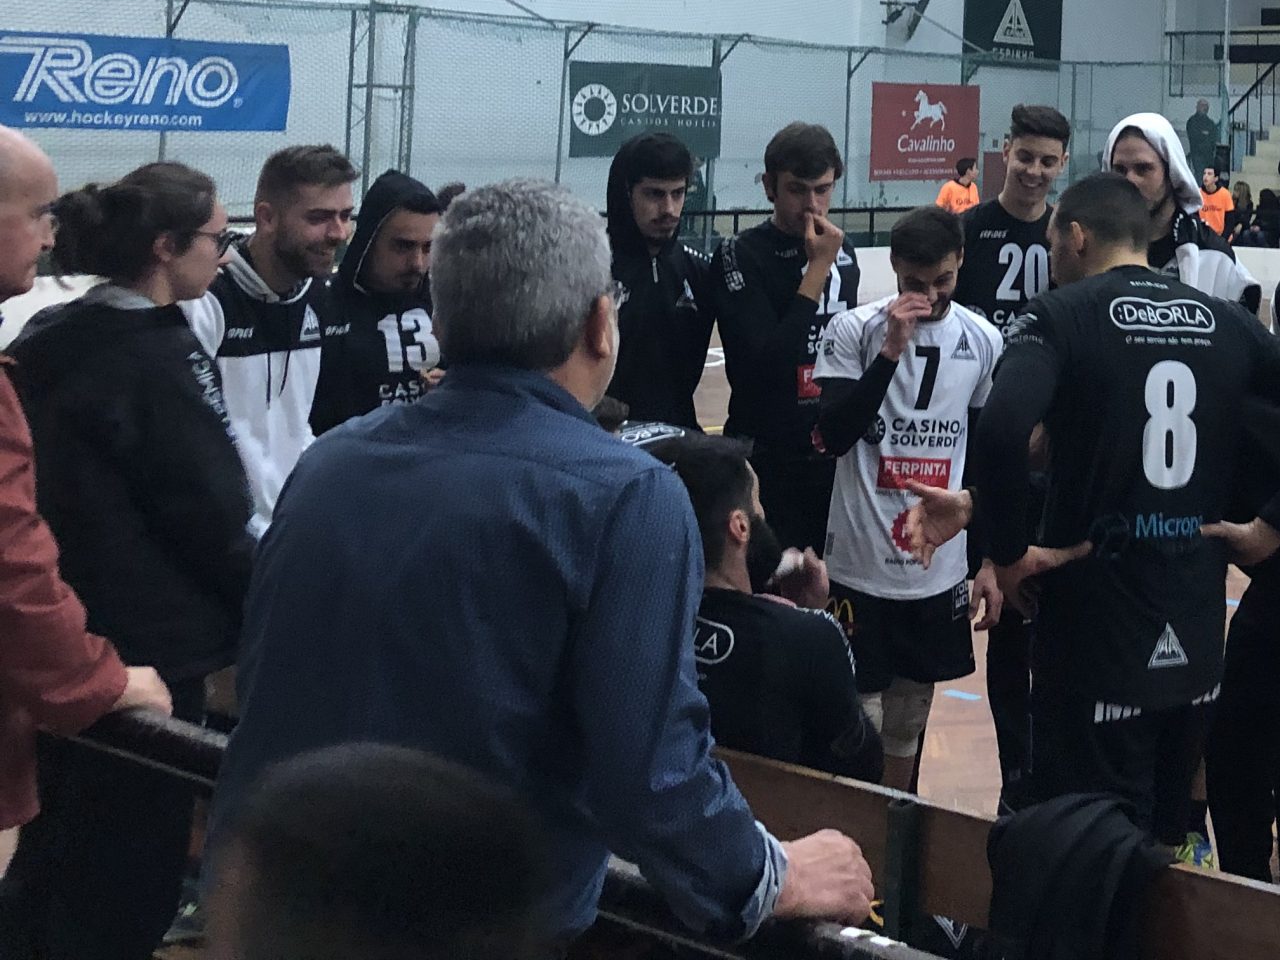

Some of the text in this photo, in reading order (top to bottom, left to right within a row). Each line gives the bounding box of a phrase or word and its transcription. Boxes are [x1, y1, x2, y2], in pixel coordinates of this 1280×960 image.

[0, 36, 239, 108] Reno
[24, 110, 202, 128] www.hockeyreno.com
[897, 135, 955, 153] Cavalinho
[995, 242, 1050, 301] 20
[377, 308, 441, 373] 13
[914, 345, 941, 411] 7
[892, 418, 960, 435] CASINO
[1142, 359, 1197, 490] 8
[884, 460, 947, 476] FERPINTA
